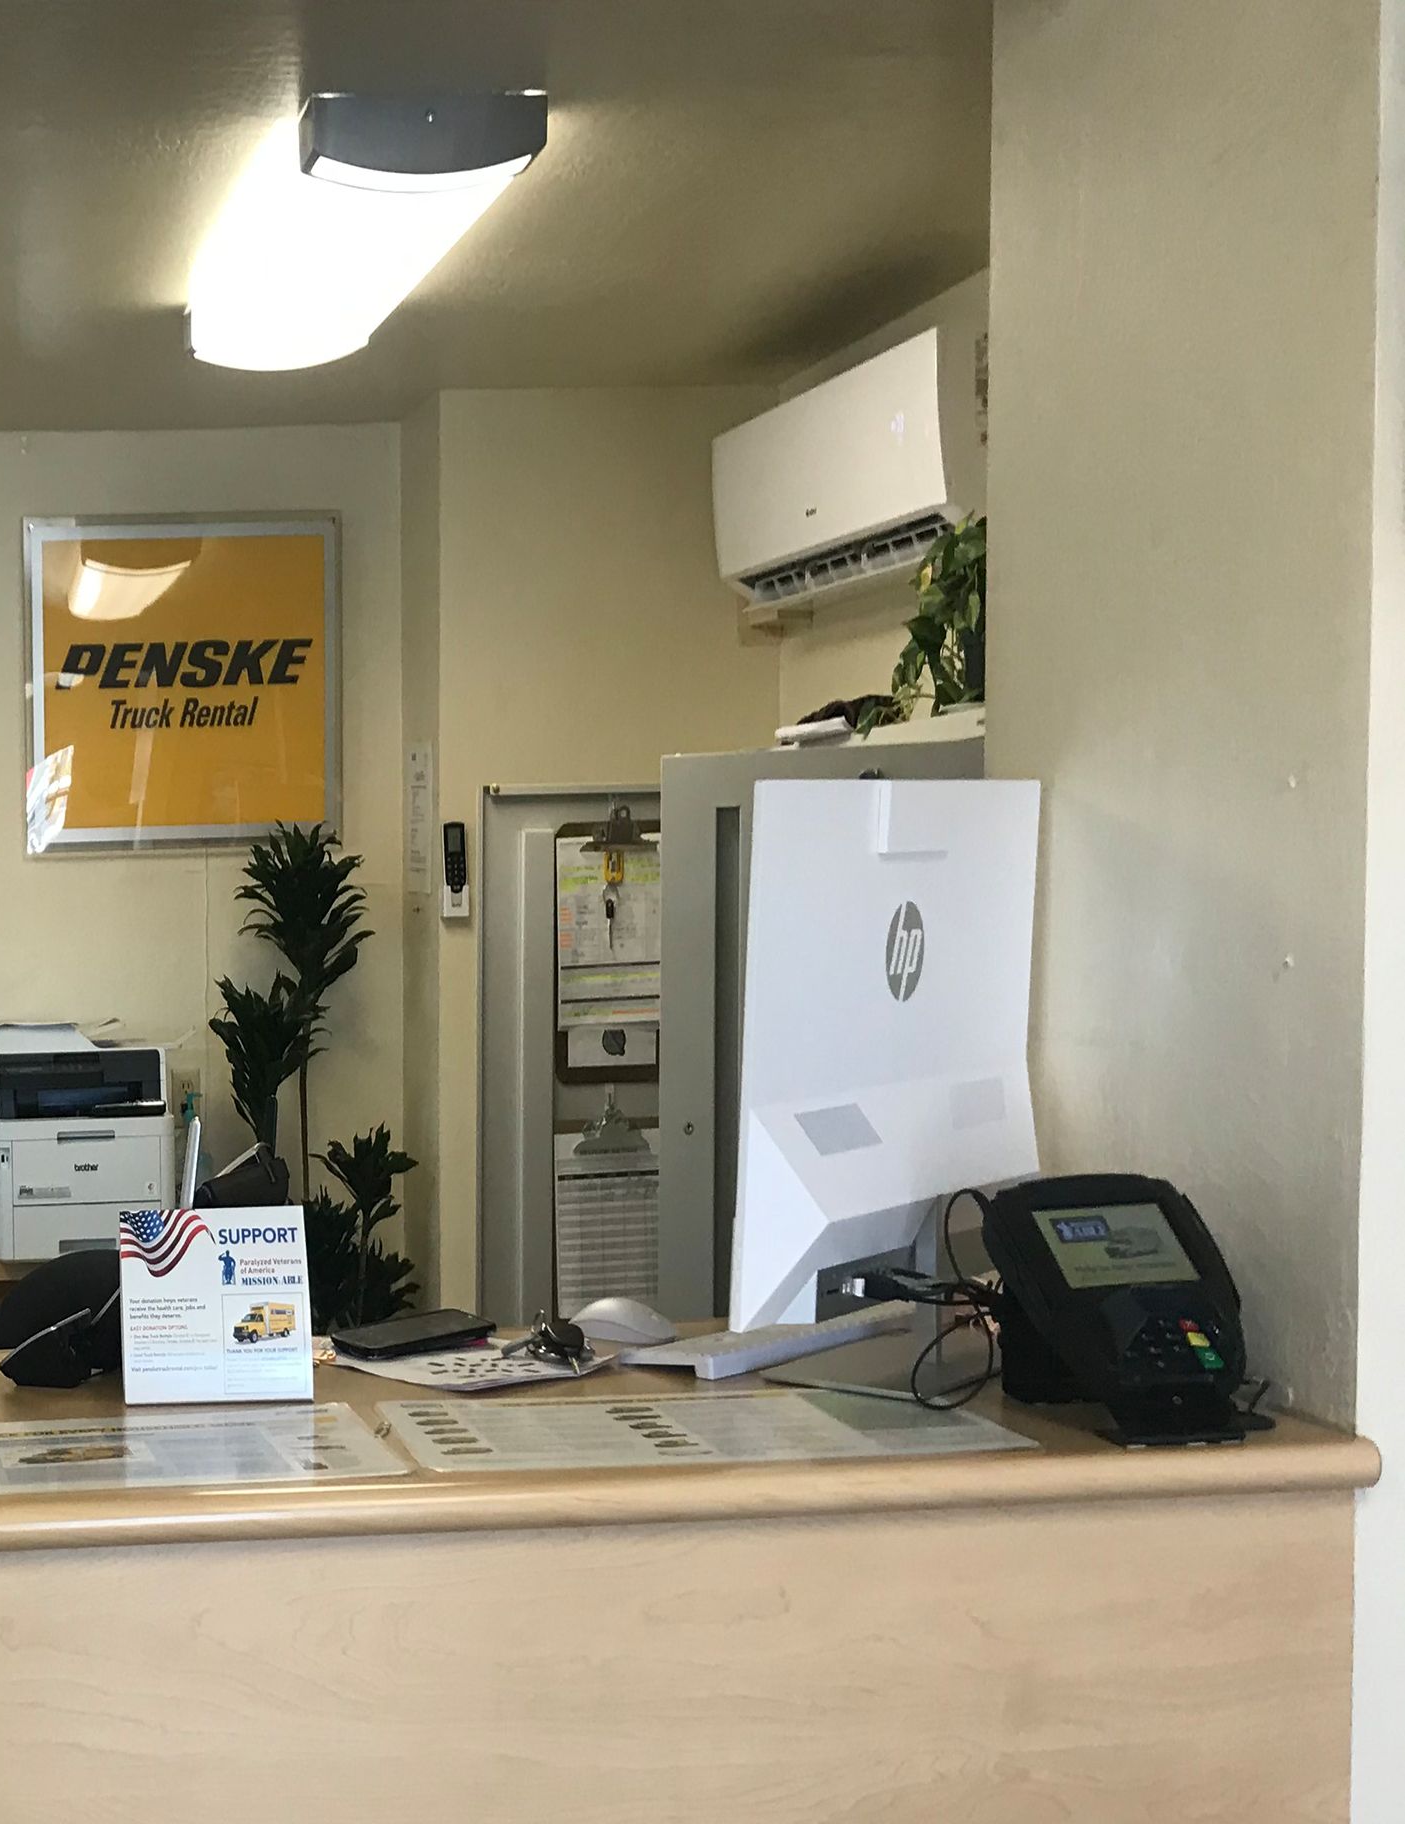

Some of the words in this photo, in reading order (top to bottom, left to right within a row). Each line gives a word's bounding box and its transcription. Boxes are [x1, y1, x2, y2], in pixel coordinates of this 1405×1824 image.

[55, 638, 313, 690] PENSKE
[110, 699, 172, 729] Truck
[179, 697, 259, 728] Rental
[887, 900, 923, 1002] hp
[74, 1163, 99, 1172] brother
[218, 1227, 298, 1245] SUPPORT
[239, 1257, 272, 1268] Paralyzed
[272, 1257, 302, 1265] Veterans
[248, 1266, 276, 1274] America
